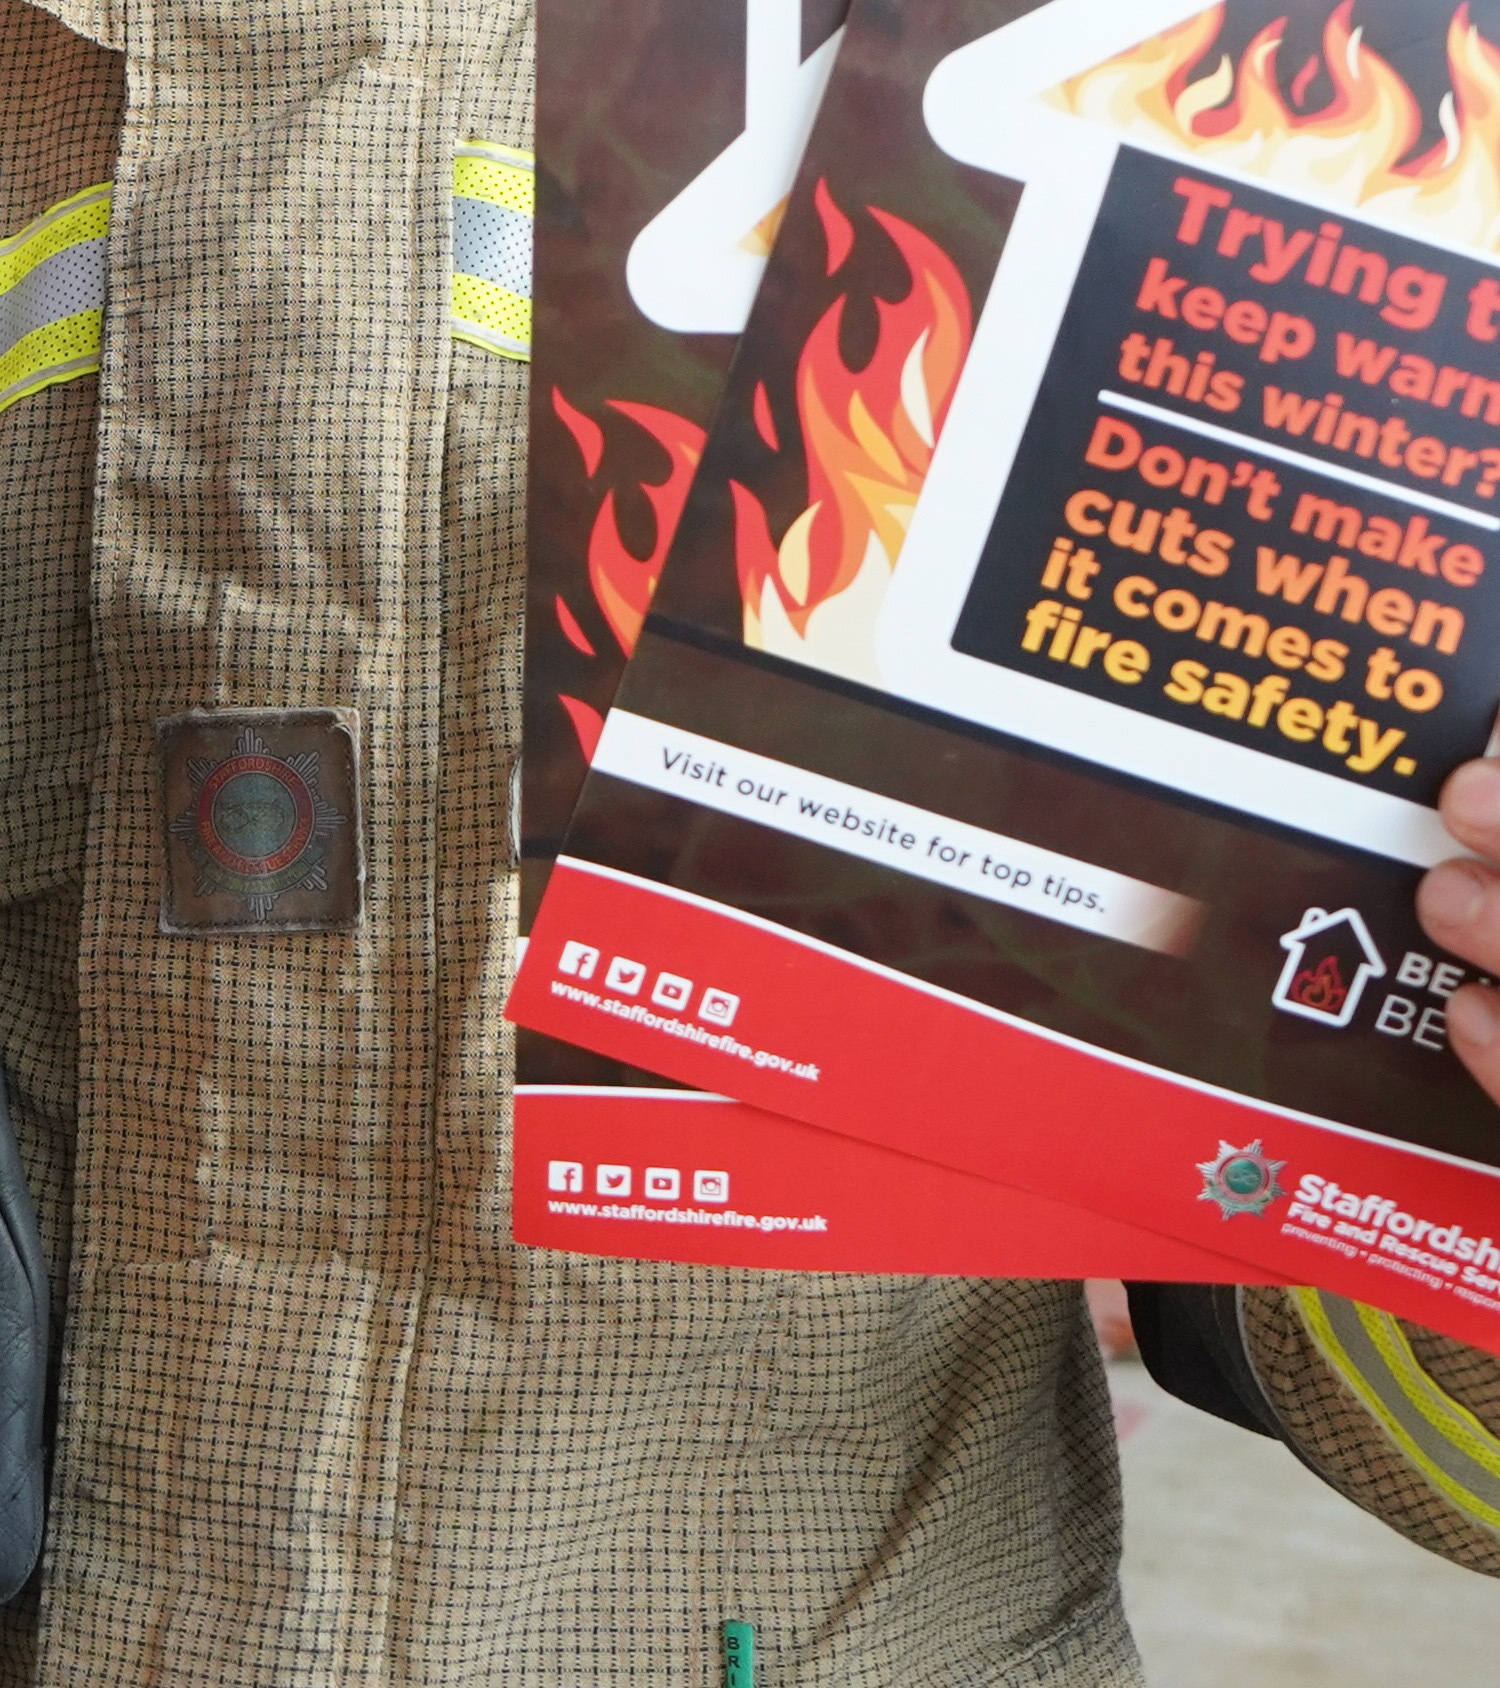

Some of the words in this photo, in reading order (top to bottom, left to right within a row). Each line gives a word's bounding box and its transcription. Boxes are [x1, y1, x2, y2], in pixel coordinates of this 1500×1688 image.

[1174, 177, 1446, 330] Trying
[1136, 257, 1315, 363] keep
[1119, 333, 1245, 412] this
[1085, 416, 1281, 521] Don't
[1290, 493, 1484, 586] make
[1041, 537, 1100, 600] it
[1113, 575, 1349, 681] comes
[1365, 647, 1443, 712] to
[1065, 489, 1234, 576] cuts
[1256, 546, 1464, 654] when
[1021, 599, 1150, 683] fire
[1163, 660, 1416, 775] safety.
[663, 748, 727, 787] Visit
[736, 779, 788, 806] our
[799, 798, 916, 850] website
[927, 836, 971, 866] for
[981, 855, 1032, 888] top
[1043, 876, 1105, 912] tips.
[1375, 994, 1446, 1051] BE
[1396, 952, 1466, 997] BE
[550, 978, 821, 1082] www.staffordshirefire.gov.uk
[547, 1200, 828, 1232] www.staffordshirefire.gov.uk
[1287, 1203, 1333, 1229] Fire
[1334, 1222, 1378, 1245] and
[1379, 1233, 1459, 1275] Rescue
